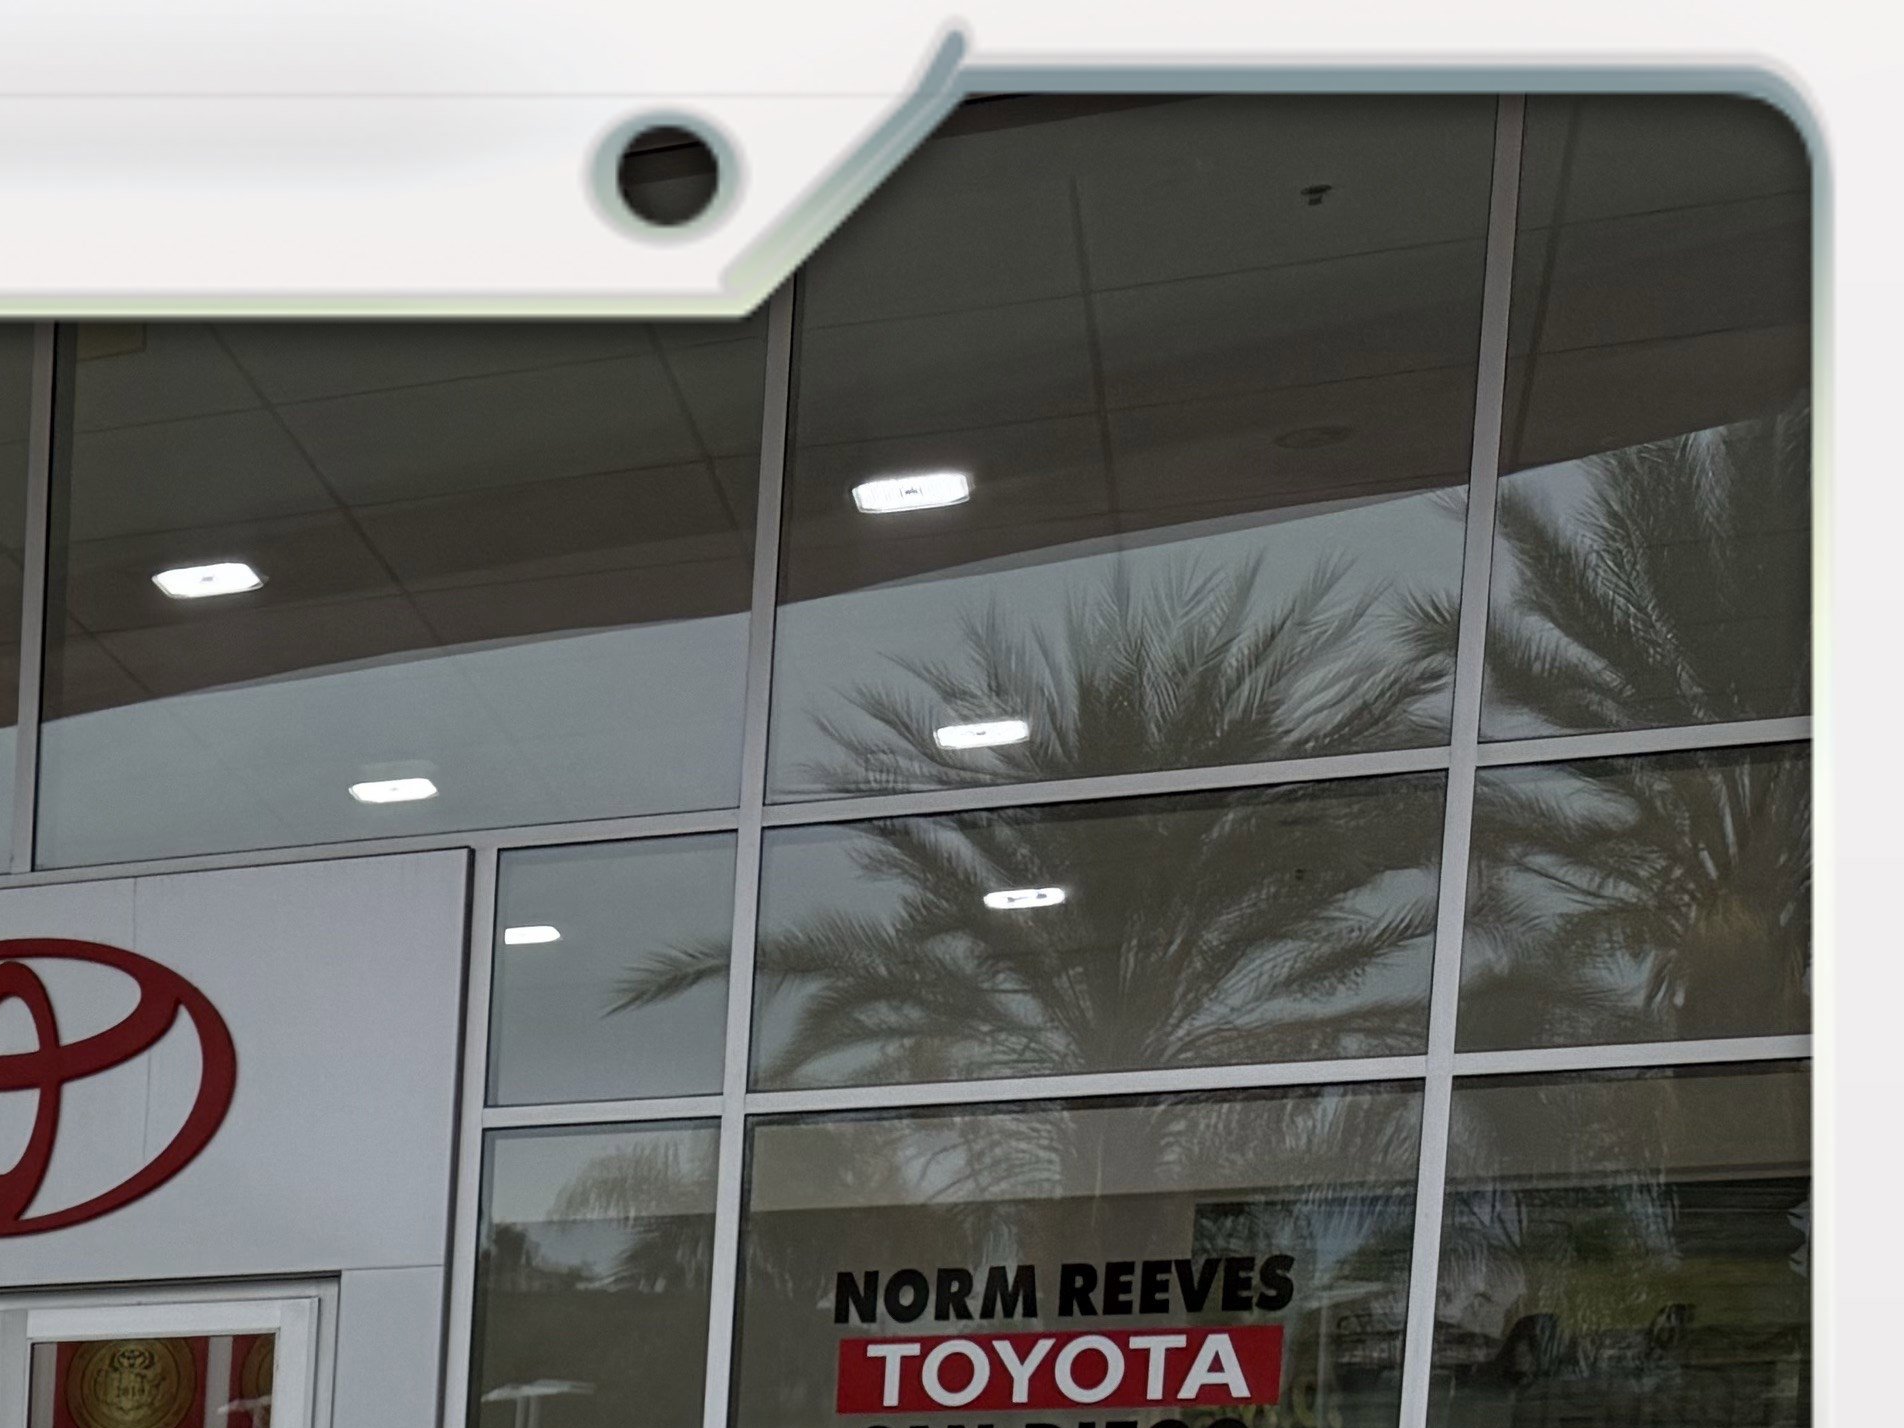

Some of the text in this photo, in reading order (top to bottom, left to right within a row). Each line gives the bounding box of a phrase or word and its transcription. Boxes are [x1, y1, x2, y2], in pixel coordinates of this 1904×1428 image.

[833, 1254, 1296, 1324] NORM REEVES
[867, 1334, 1251, 1408] TOYOTA
